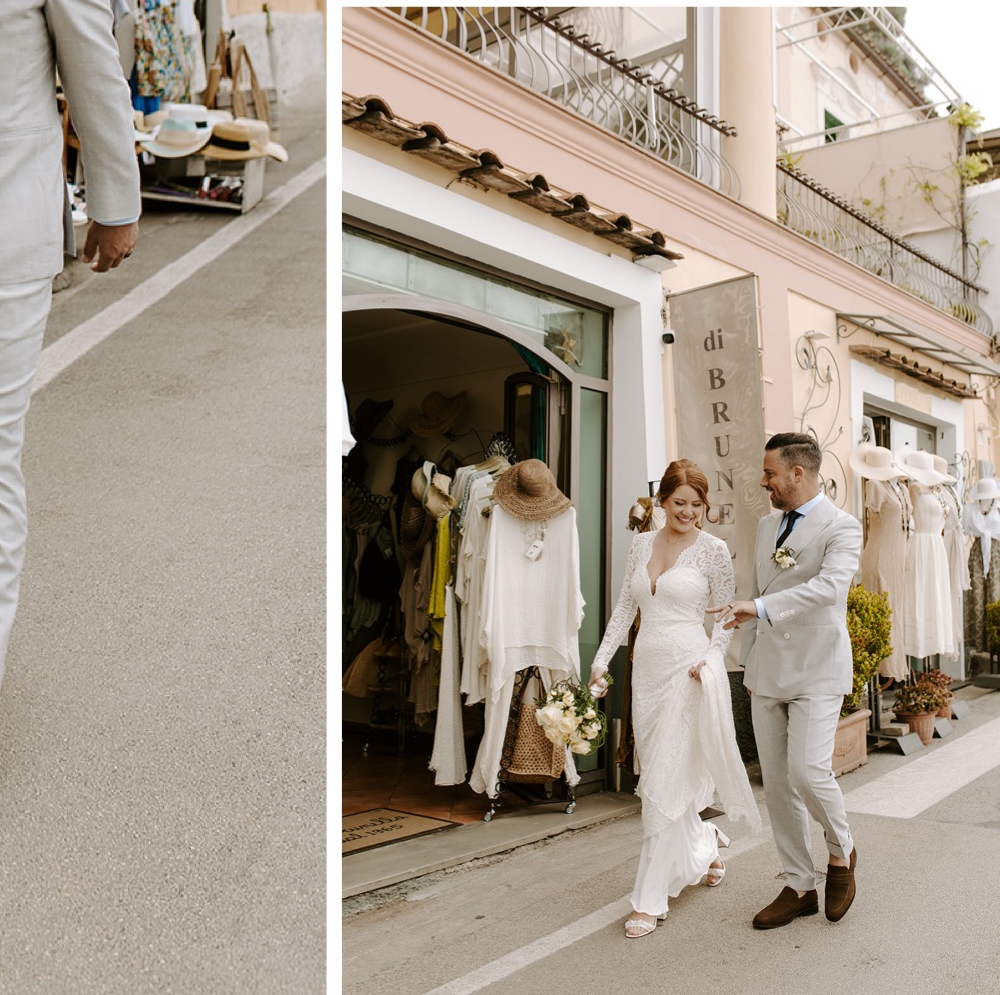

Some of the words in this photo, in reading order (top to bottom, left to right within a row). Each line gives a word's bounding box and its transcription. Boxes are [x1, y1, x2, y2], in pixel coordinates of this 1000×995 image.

[703, 328, 724, 353] di
[708, 367, 737, 560] BRUNE
[366, 824, 404, 836] 1965
